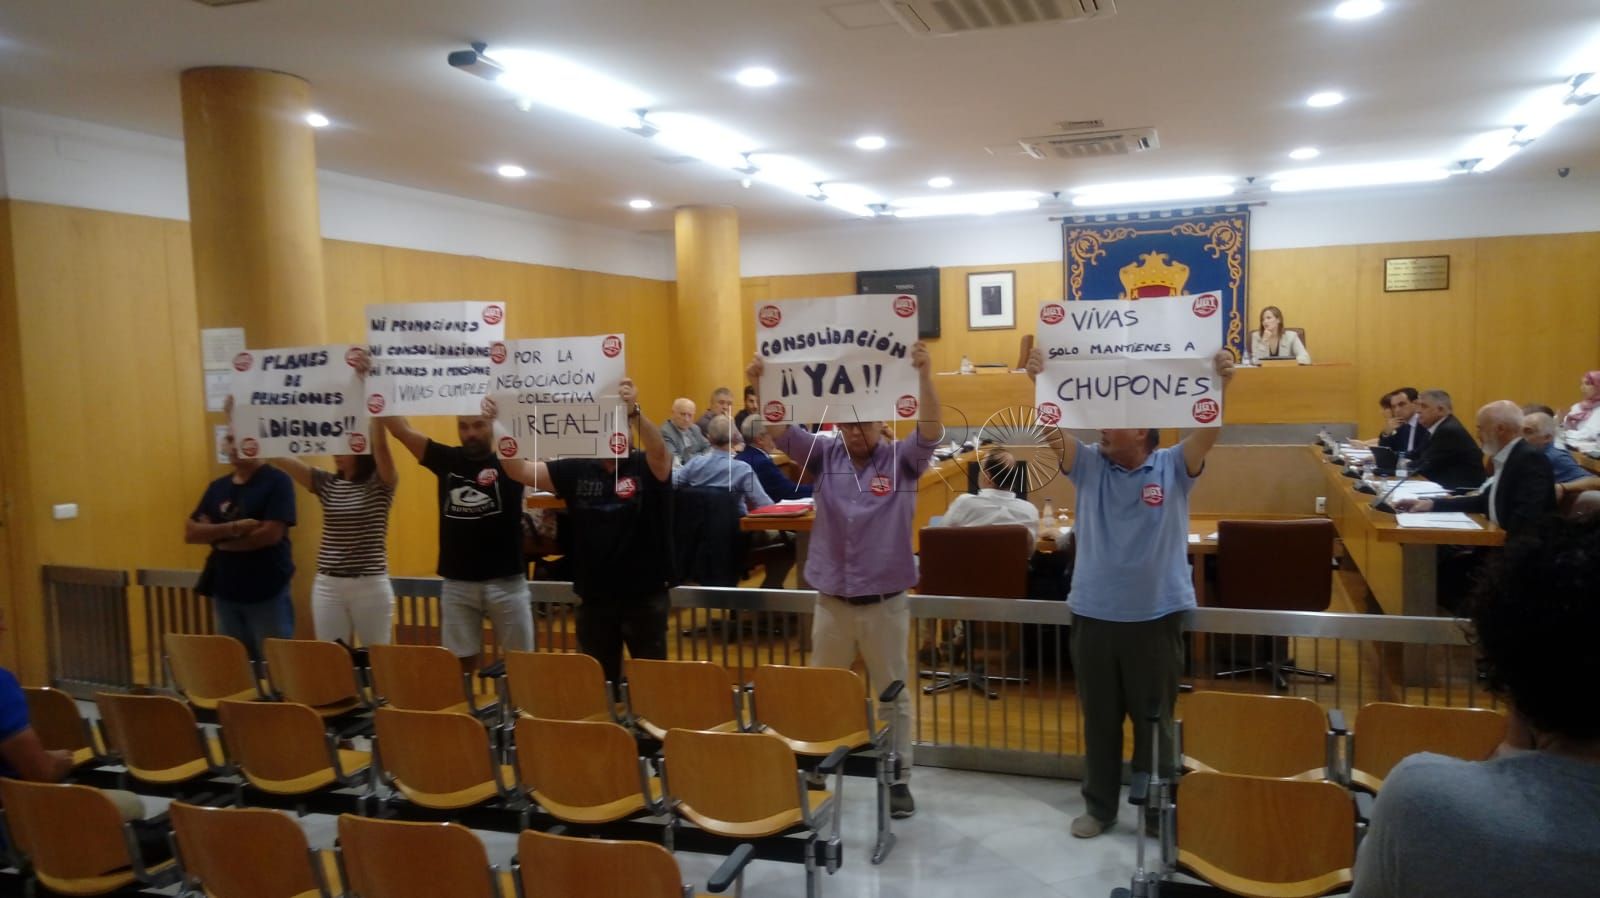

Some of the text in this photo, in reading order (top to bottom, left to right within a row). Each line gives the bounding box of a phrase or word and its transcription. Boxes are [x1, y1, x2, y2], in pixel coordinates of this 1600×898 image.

[387, 342, 491, 357] CONSOLIDACIONE
[514, 350, 543, 364] POR
[557, 349, 574, 363] LA
[1048, 346, 1080, 360] SOLO
[1184, 342, 1196, 352] A
[261, 350, 329, 371] PLANES
[385, 365, 428, 376] PLANES
[446, 364, 491, 377] PENSIONE
[284, 374, 302, 387] DE
[1057, 374, 1211, 402] CHUPONES
[517, 391, 595, 404] COLECTIVA
